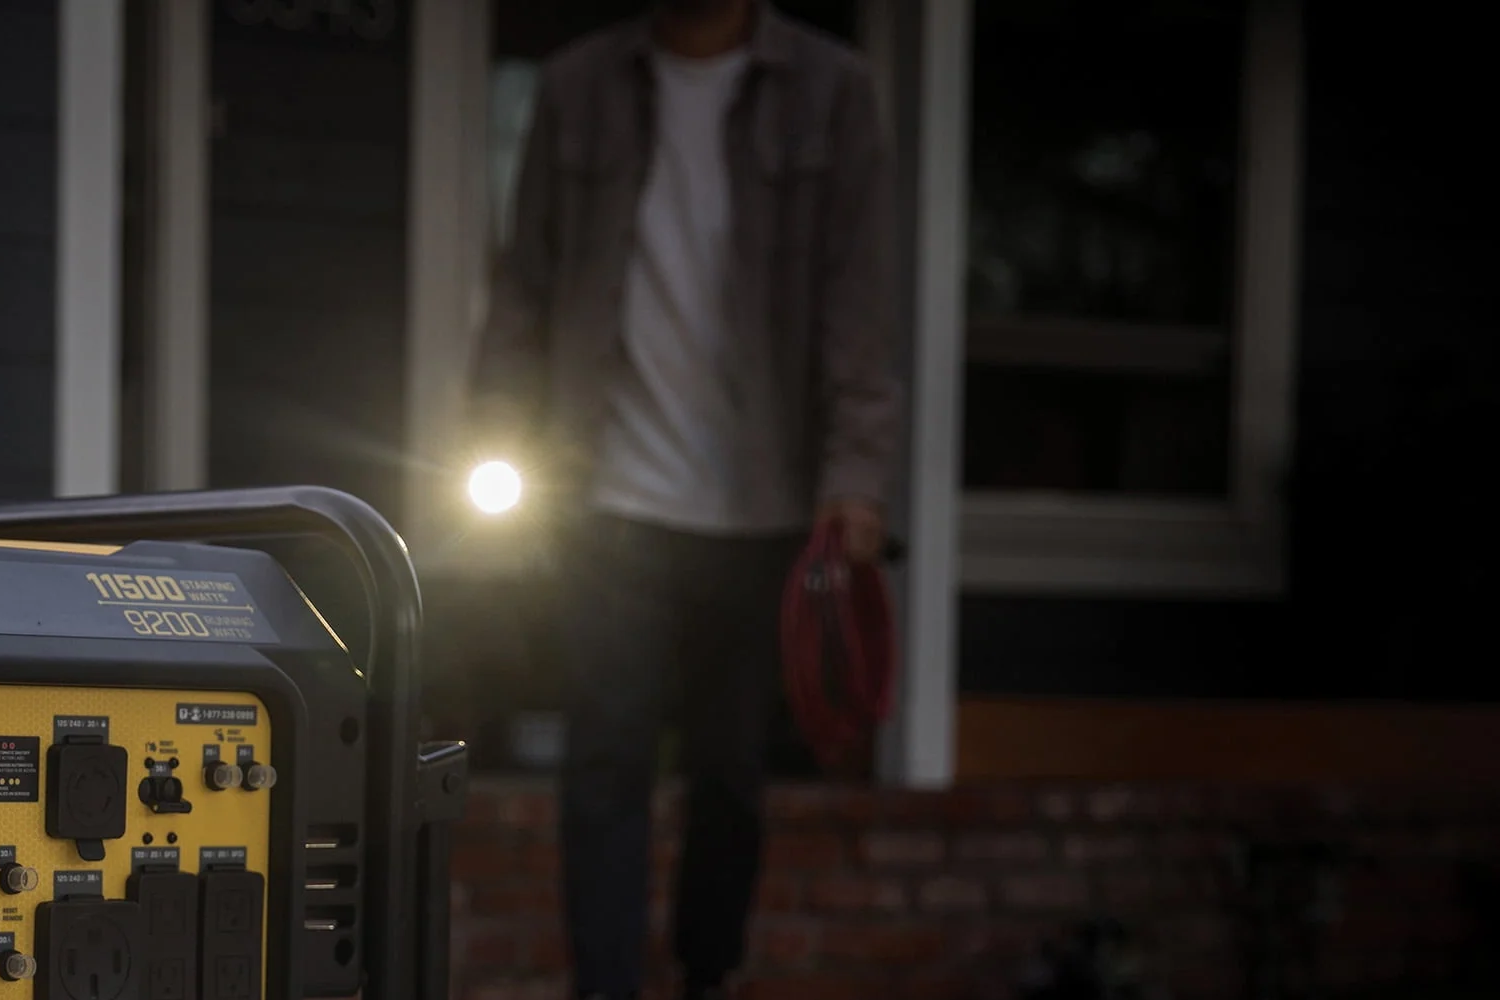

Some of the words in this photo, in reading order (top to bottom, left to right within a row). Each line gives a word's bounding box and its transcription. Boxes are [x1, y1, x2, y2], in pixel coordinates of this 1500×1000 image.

[85, 572, 186, 602] 11500
[179, 579, 236, 593] STARTING
[187, 592, 229, 603] WATTS
[123, 609, 210, 638] 9200
[211, 627, 252, 639] WATTS
